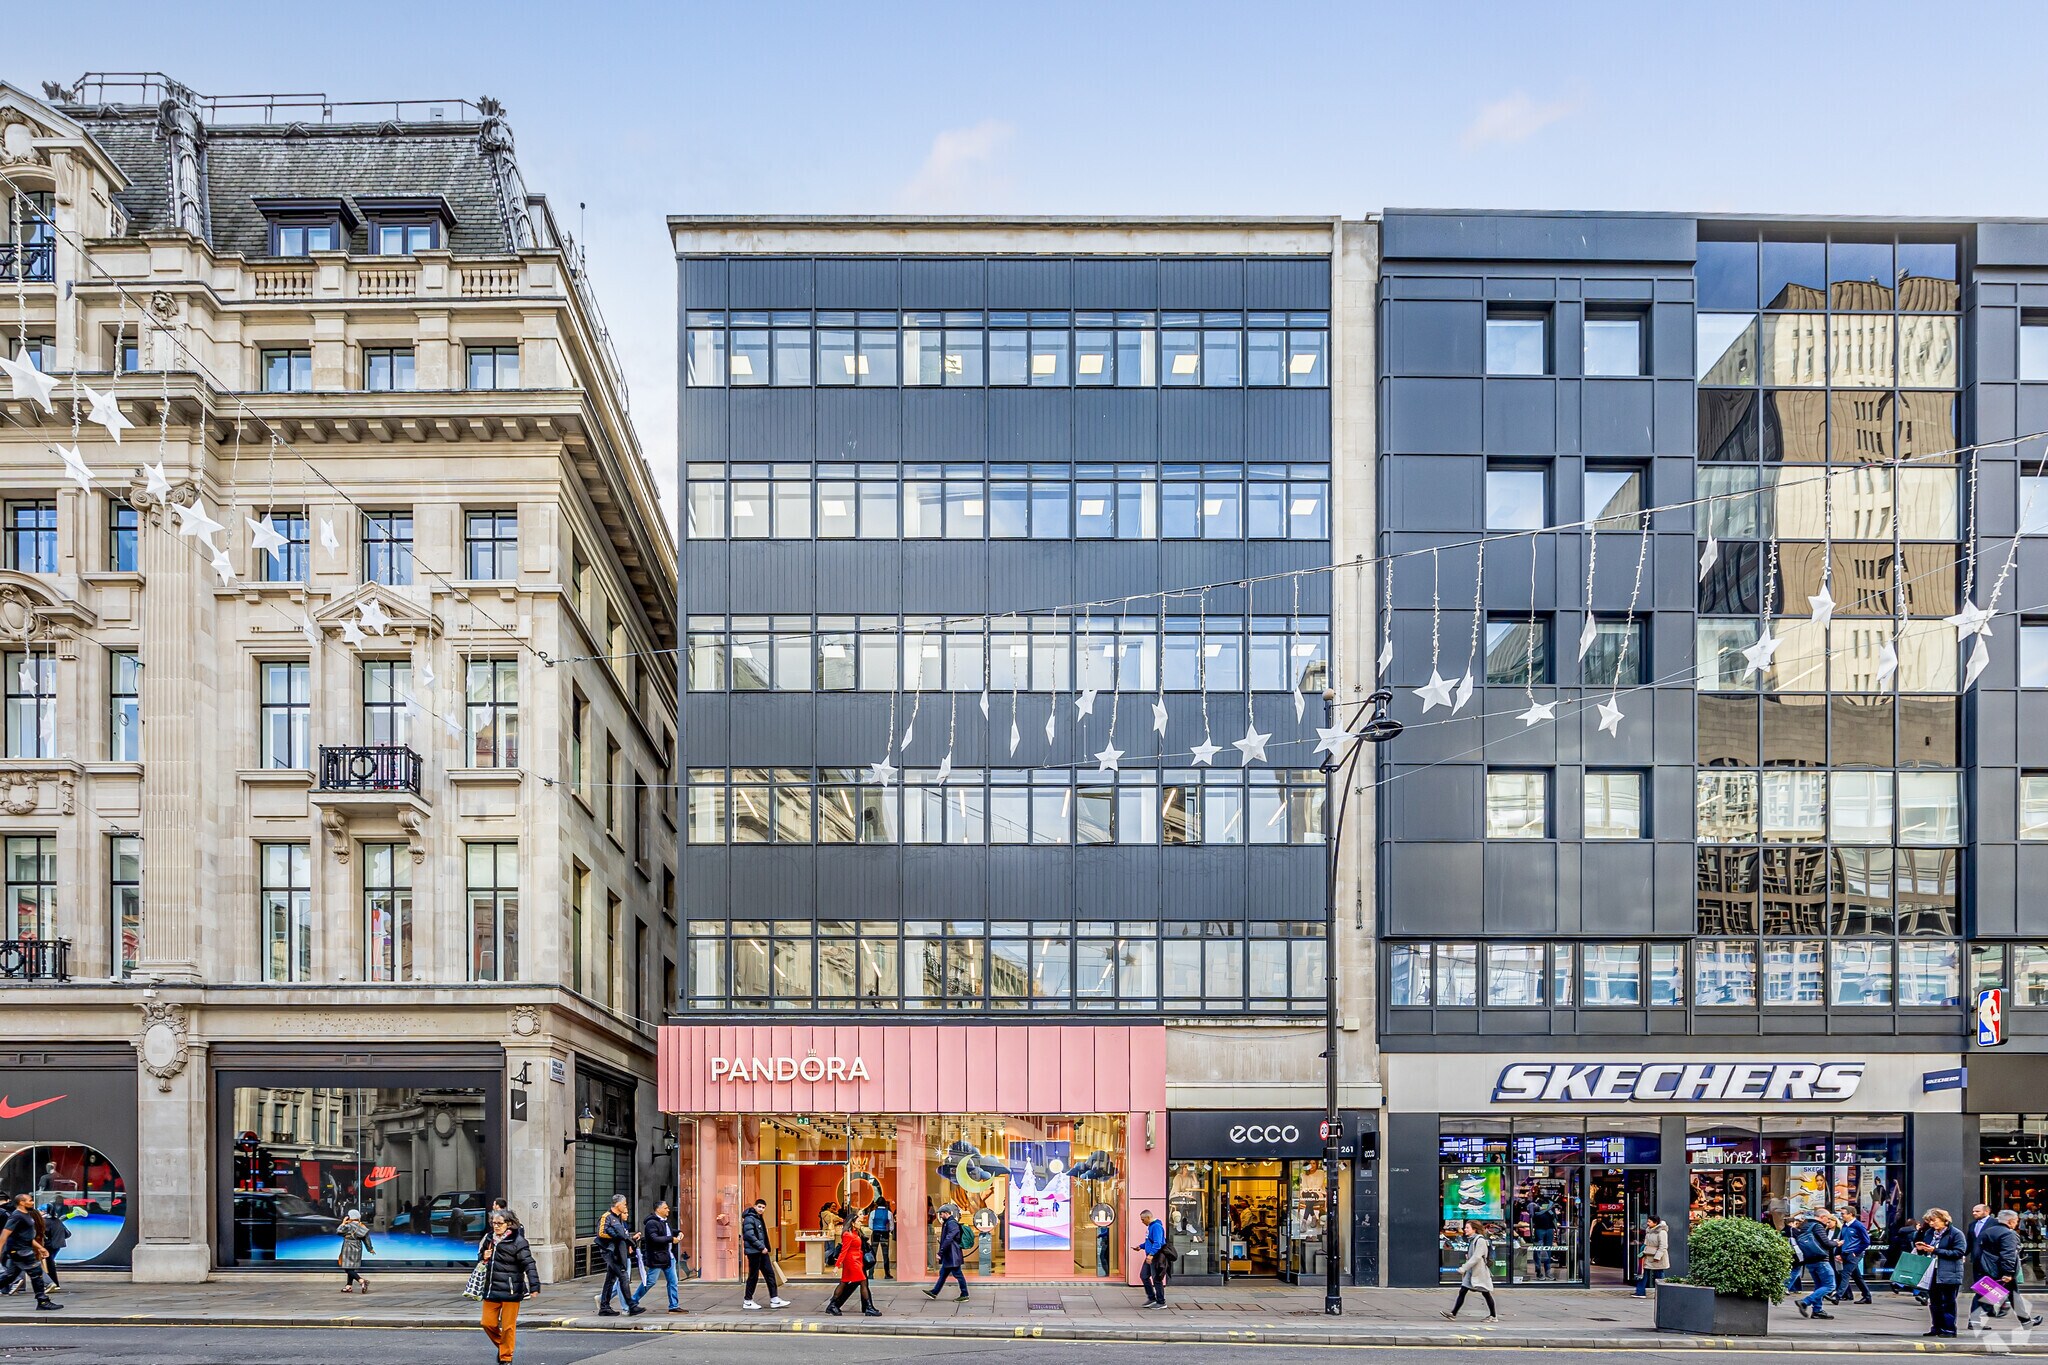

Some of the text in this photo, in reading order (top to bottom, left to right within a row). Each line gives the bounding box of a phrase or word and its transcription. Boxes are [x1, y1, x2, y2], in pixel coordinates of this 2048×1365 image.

[711, 1057, 870, 1082] PANDORA
[1493, 1063, 1865, 1101] SKECHERS
[1925, 1076, 1960, 1085] SKECHERS
[1229, 1125, 1300, 1143] ecco
[1321, 1126, 1328, 1135] 20
[371, 1166, 397, 1178] RUN
[1980, 1281, 2003, 1299] LIBERTY
